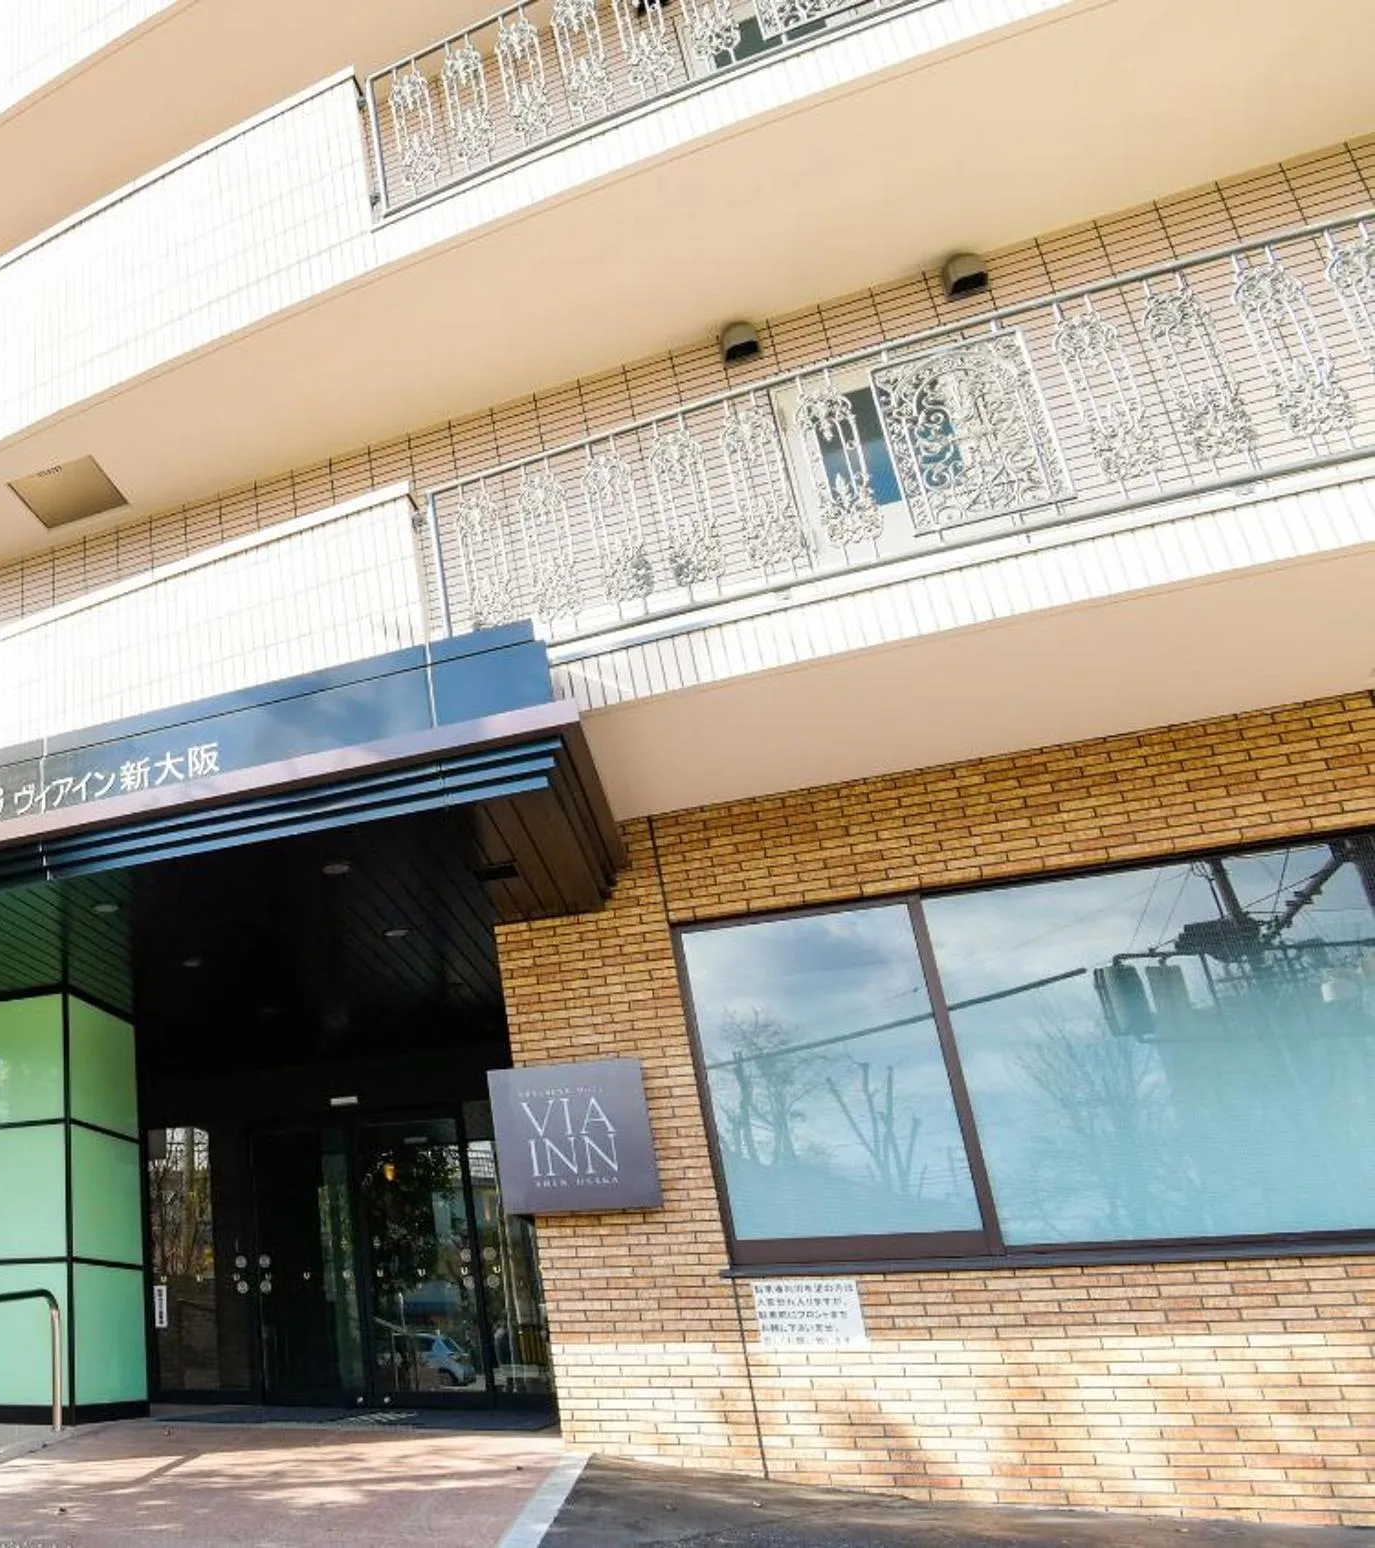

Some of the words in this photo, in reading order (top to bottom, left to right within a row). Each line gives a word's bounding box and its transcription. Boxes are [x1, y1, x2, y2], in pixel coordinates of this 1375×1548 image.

[14, 742, 221, 815] ヴィアイン新大阪
[521, 1096, 617, 1136] VIA
[528, 1133, 619, 1177] INN
